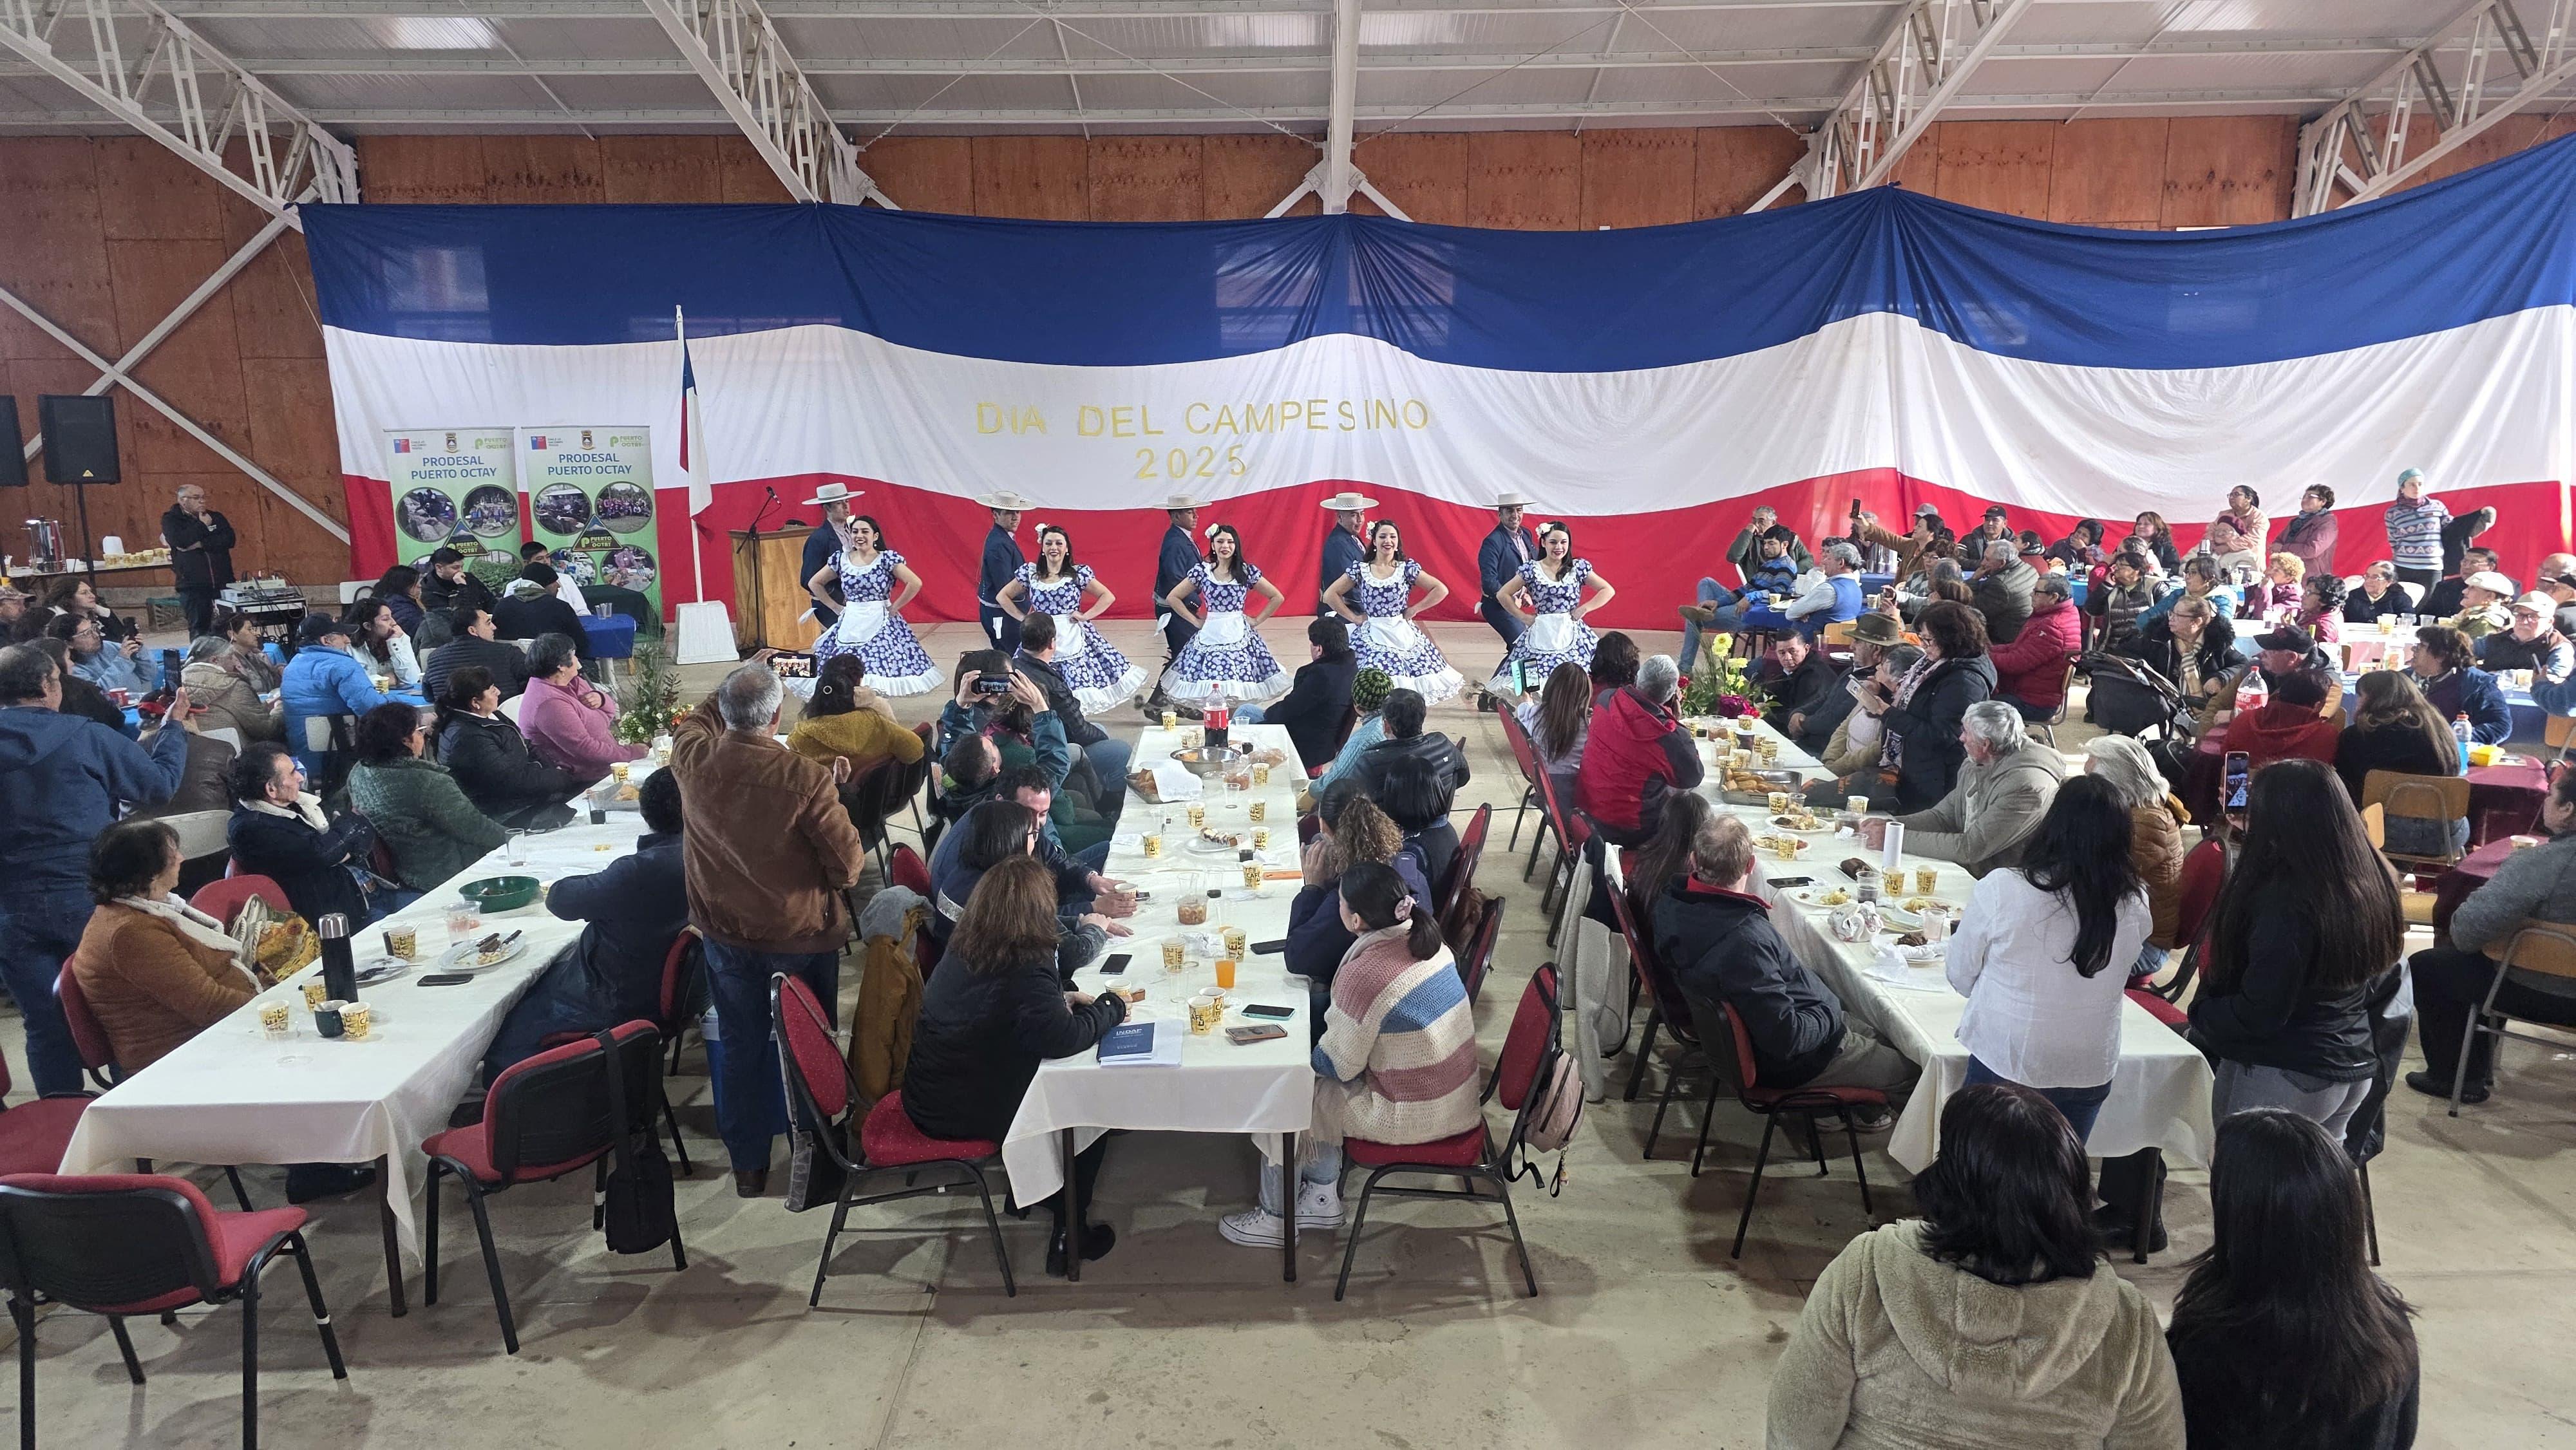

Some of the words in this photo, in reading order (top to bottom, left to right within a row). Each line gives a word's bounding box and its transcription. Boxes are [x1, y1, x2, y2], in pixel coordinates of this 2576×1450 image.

[976, 401, 1048, 435] DIA
[1077, 404, 1164, 438] DEL
[1185, 398, 1430, 435] CAMPESINO
[422, 456, 484, 467] PRODESAL
[558, 453, 620, 464] PRODESAL
[1135, 444, 1248, 480] 2025
[411, 469, 457, 480] PUERTO
[460, 467, 497, 478] OCTAY
[548, 466, 592, 476] PUERTO
[596, 465, 632, 475] OCTAY
